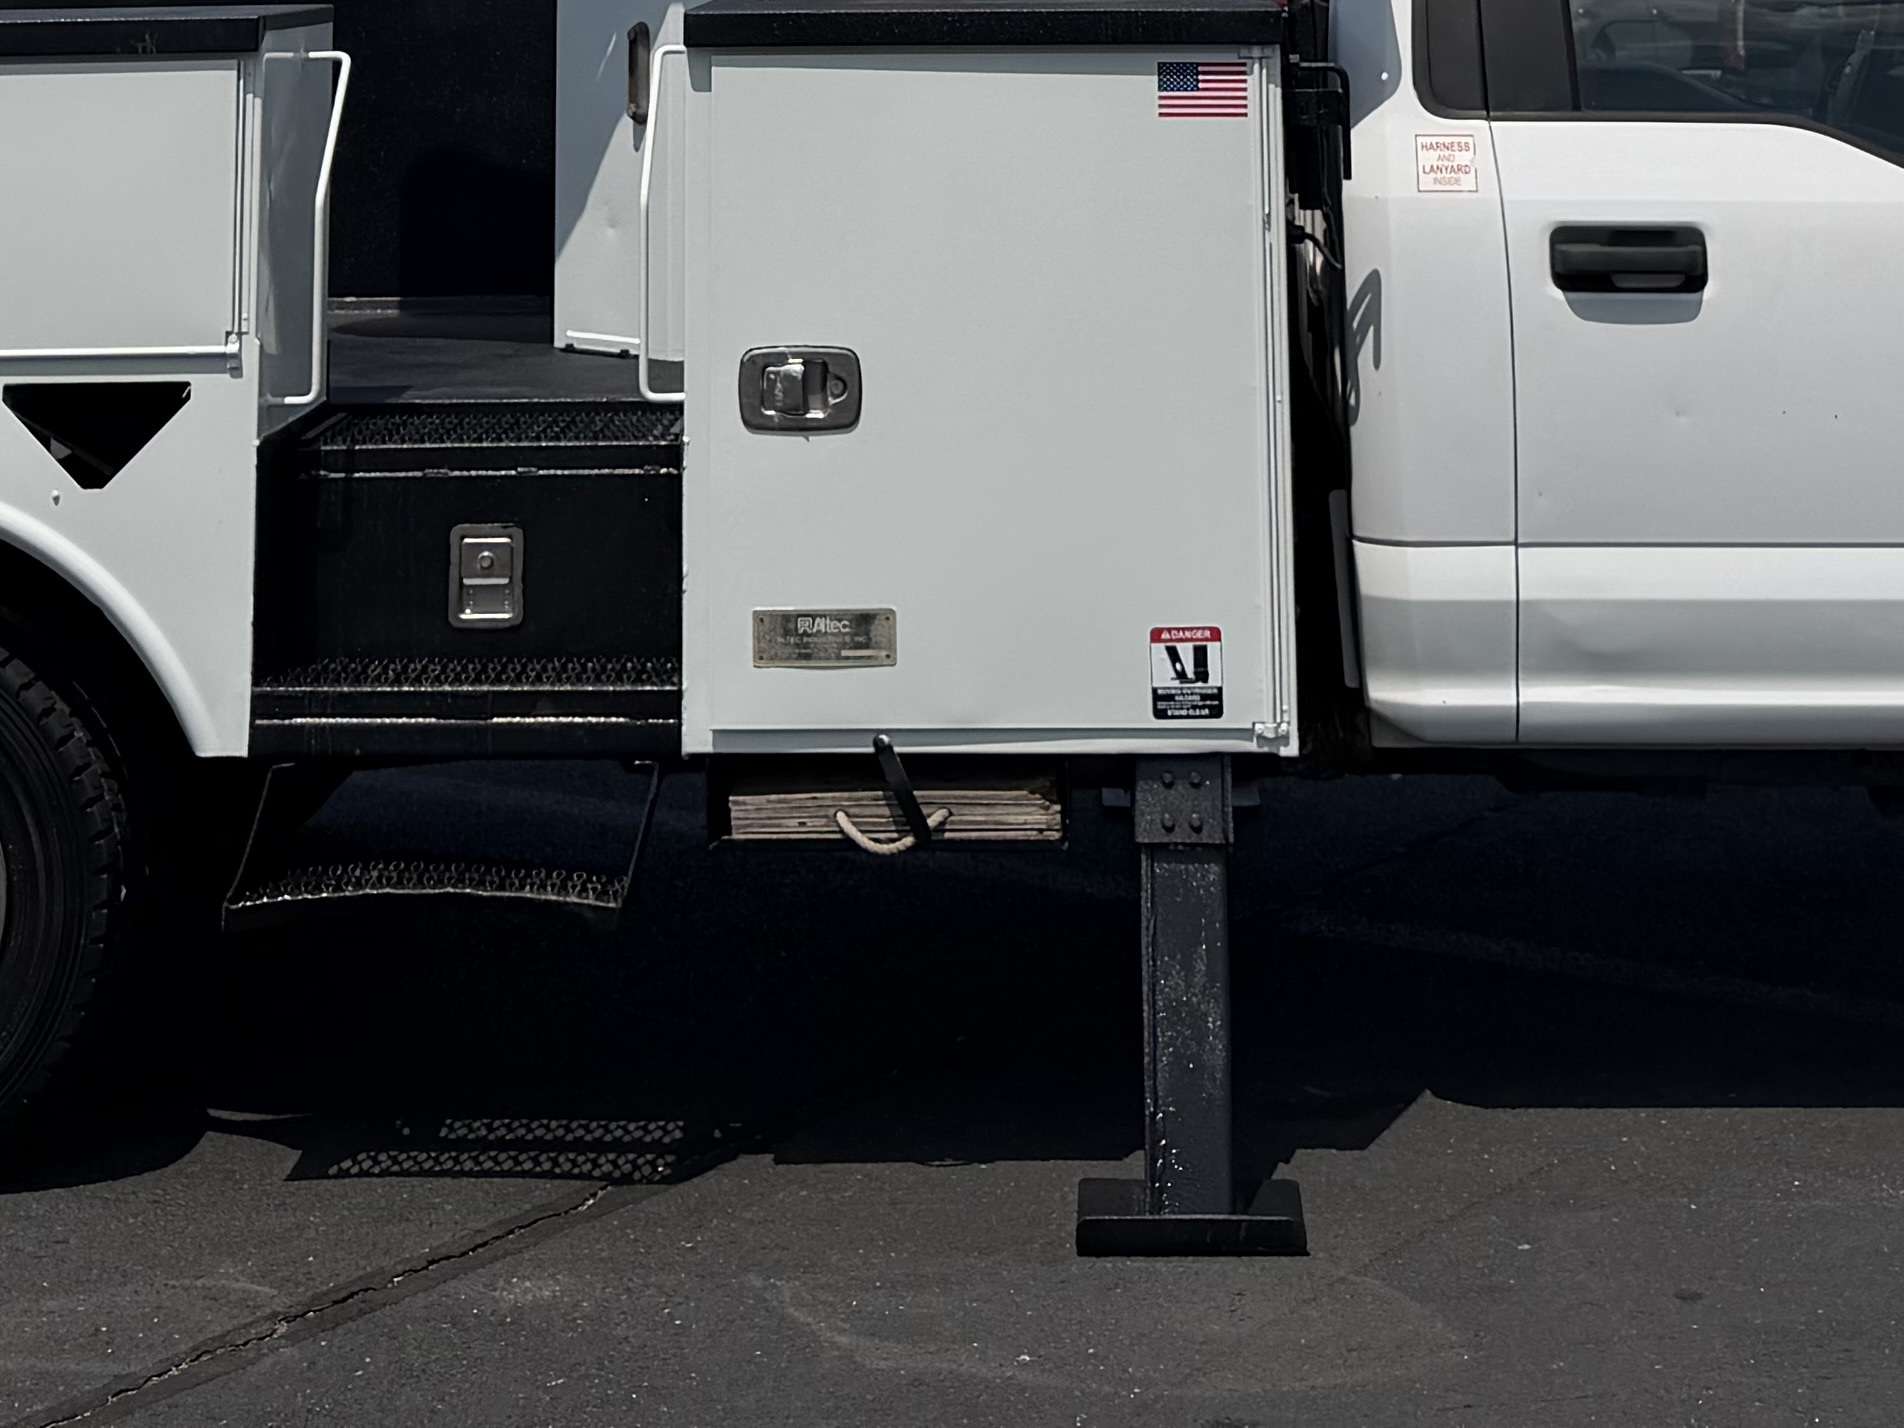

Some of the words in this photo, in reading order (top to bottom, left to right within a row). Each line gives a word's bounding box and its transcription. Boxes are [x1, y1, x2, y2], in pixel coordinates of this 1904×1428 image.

[1421, 141, 1471, 152] HARNESS
[1436, 153, 1456, 163] AND
[1422, 164, 1472, 175] LANYARD
[813, 616, 850, 633] Altec
[1170, 629, 1211, 639] DANGER
